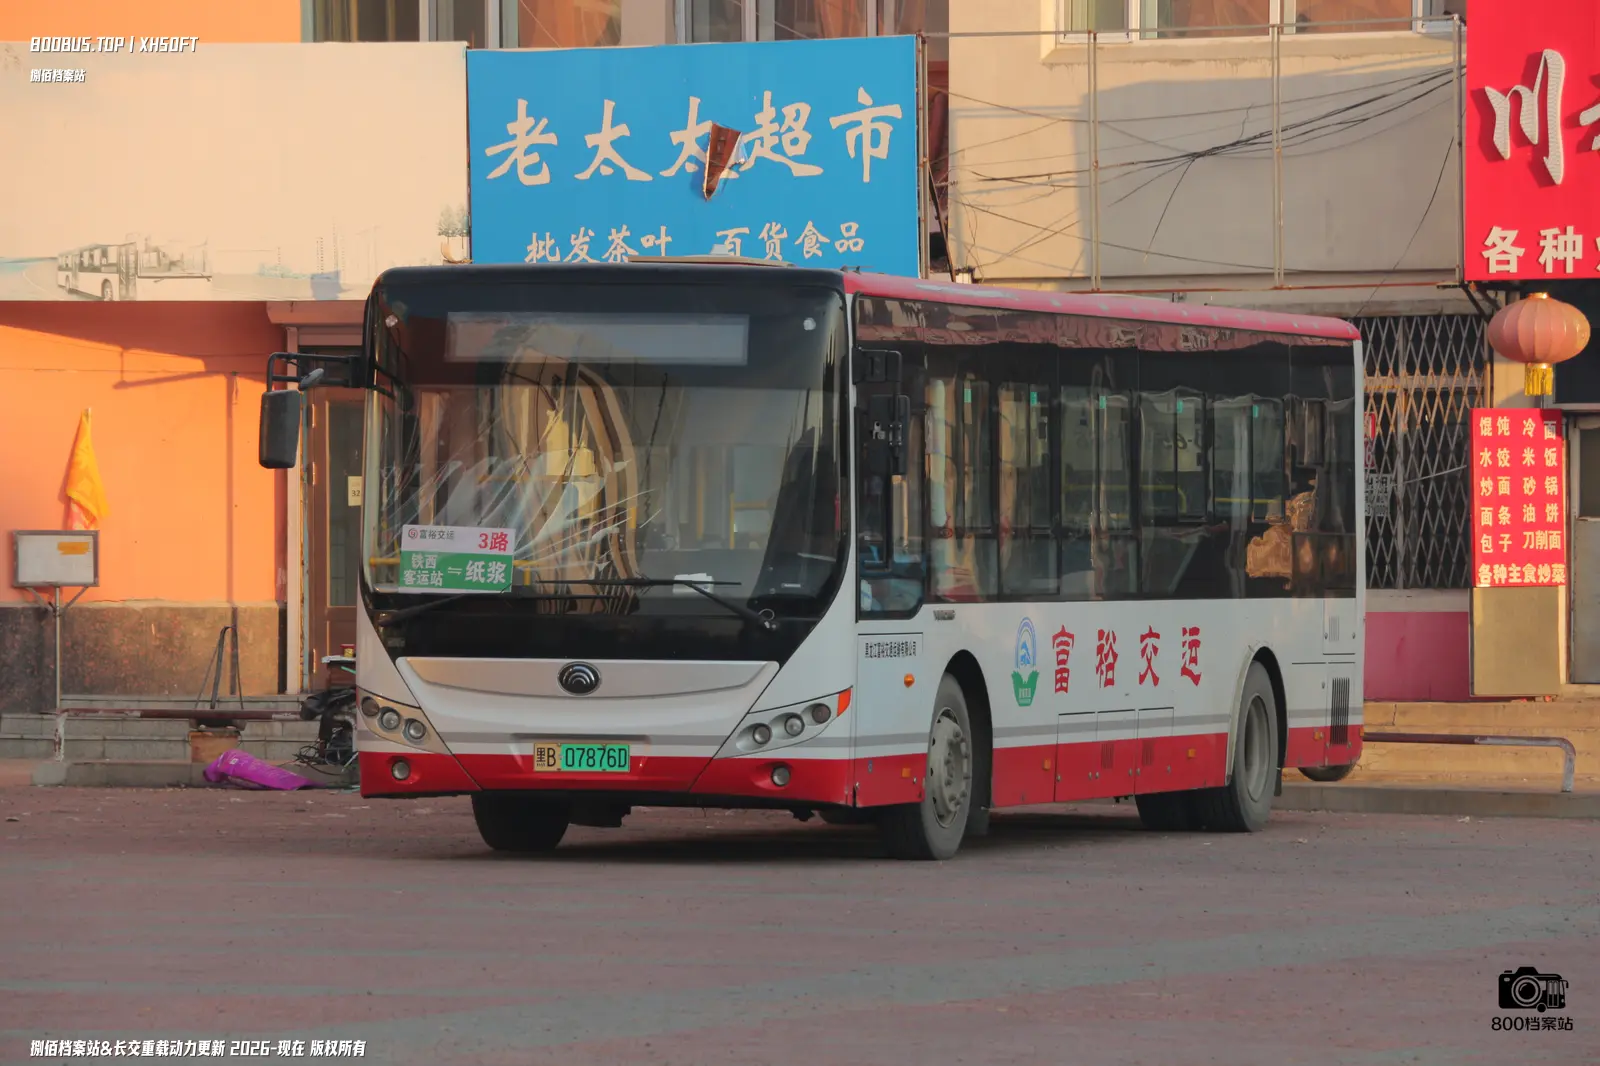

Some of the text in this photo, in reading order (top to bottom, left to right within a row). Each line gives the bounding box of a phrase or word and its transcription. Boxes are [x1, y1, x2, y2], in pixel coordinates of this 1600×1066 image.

[484, 87, 903, 186] 老太太超市
[524, 220, 865, 264] 批发茶叶 百货食品
[1481, 225, 1600, 274] 各种
[1479, 415, 1557, 440] 馄饨 冷面
[1480, 447, 1558, 467] 水饺 米饭
[1480, 476, 1559, 496] 炒面 砂锅
[1480, 503, 1559, 527] 面条 油饼
[478, 531, 508, 552] 3路
[1480, 530, 1561, 553] 包子 刀削面
[403, 569, 444, 586] 客运站
[464, 560, 507, 584] 纸浆
[1478, 563, 1566, 585] 各种主食炒菜
[1051, 624, 1203, 694] 富裕交运
[565, 747, 628, 768] 07876D
